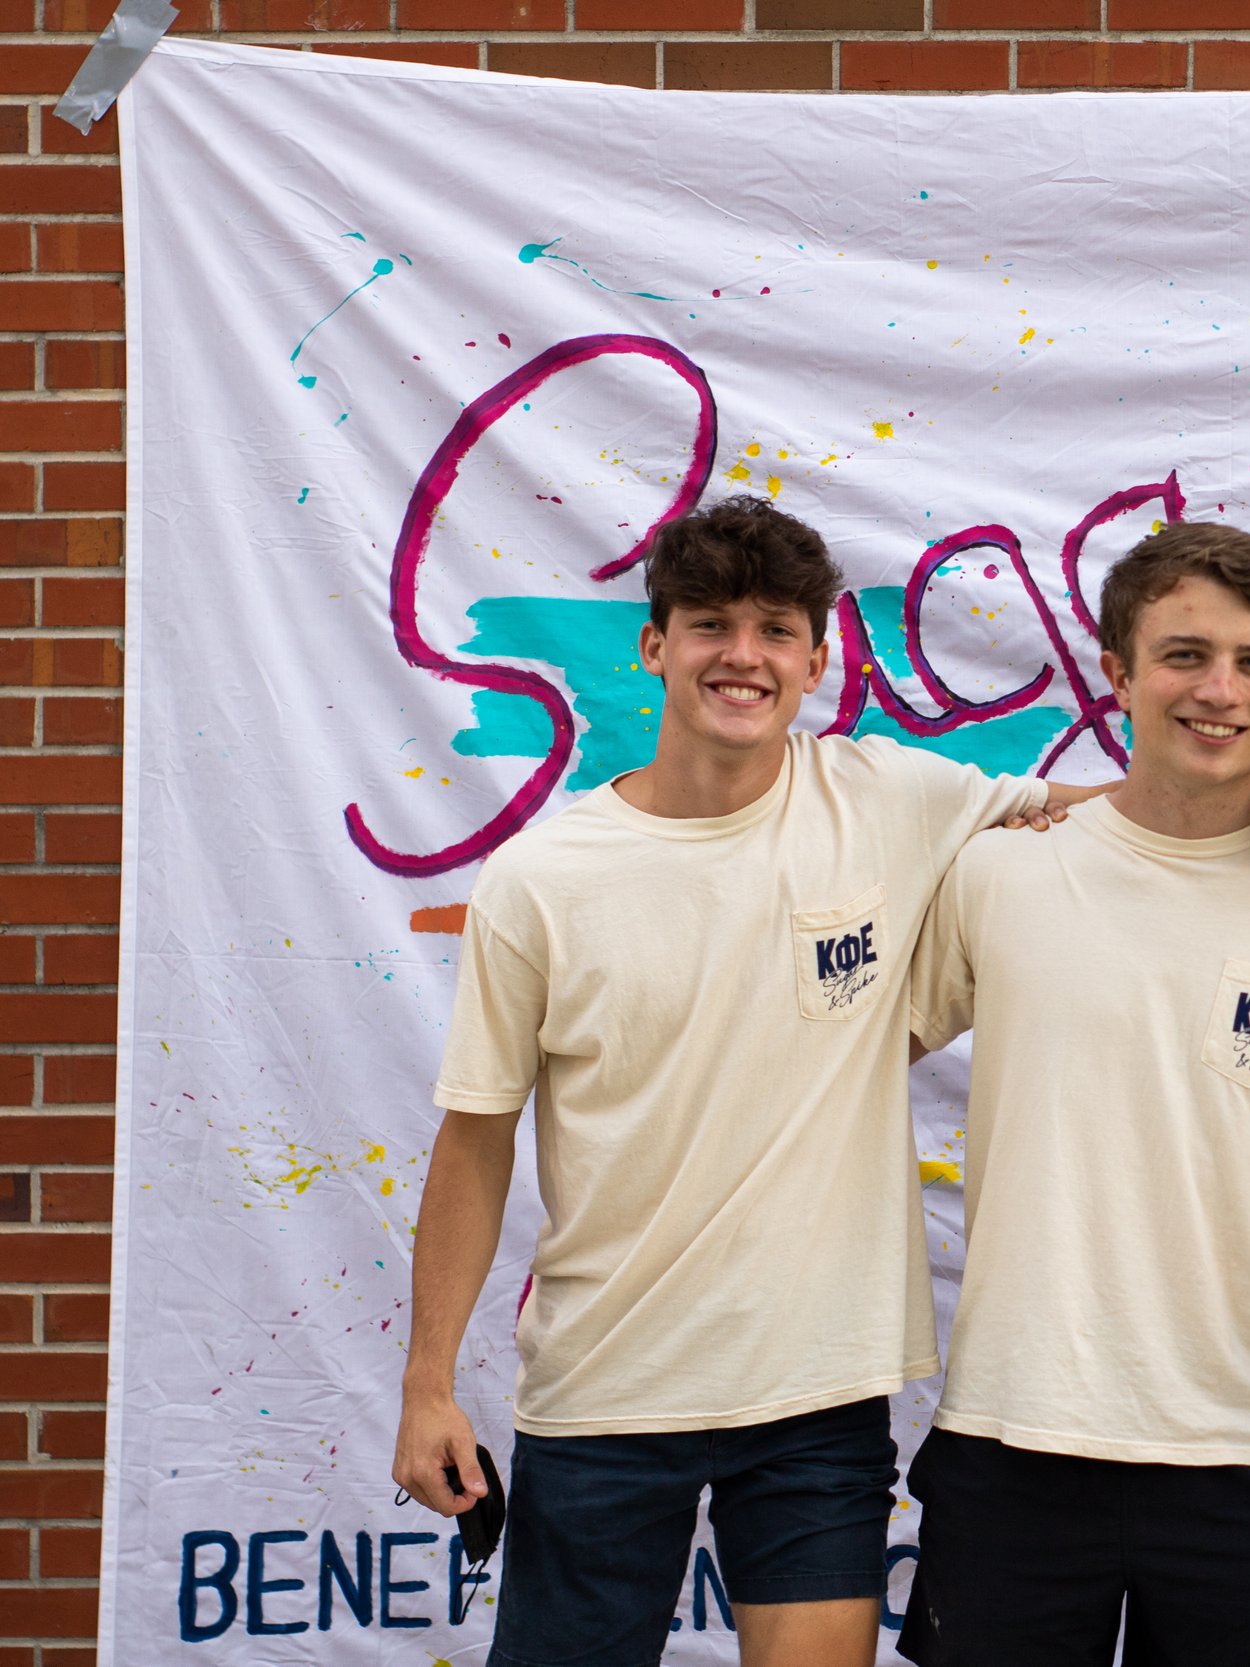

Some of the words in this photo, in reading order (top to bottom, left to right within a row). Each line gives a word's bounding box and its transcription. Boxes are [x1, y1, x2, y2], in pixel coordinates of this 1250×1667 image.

[828, 995, 840, 1011] &
[839, 970, 879, 1009] Spike
[1235, 1053, 1249, 1068] &
